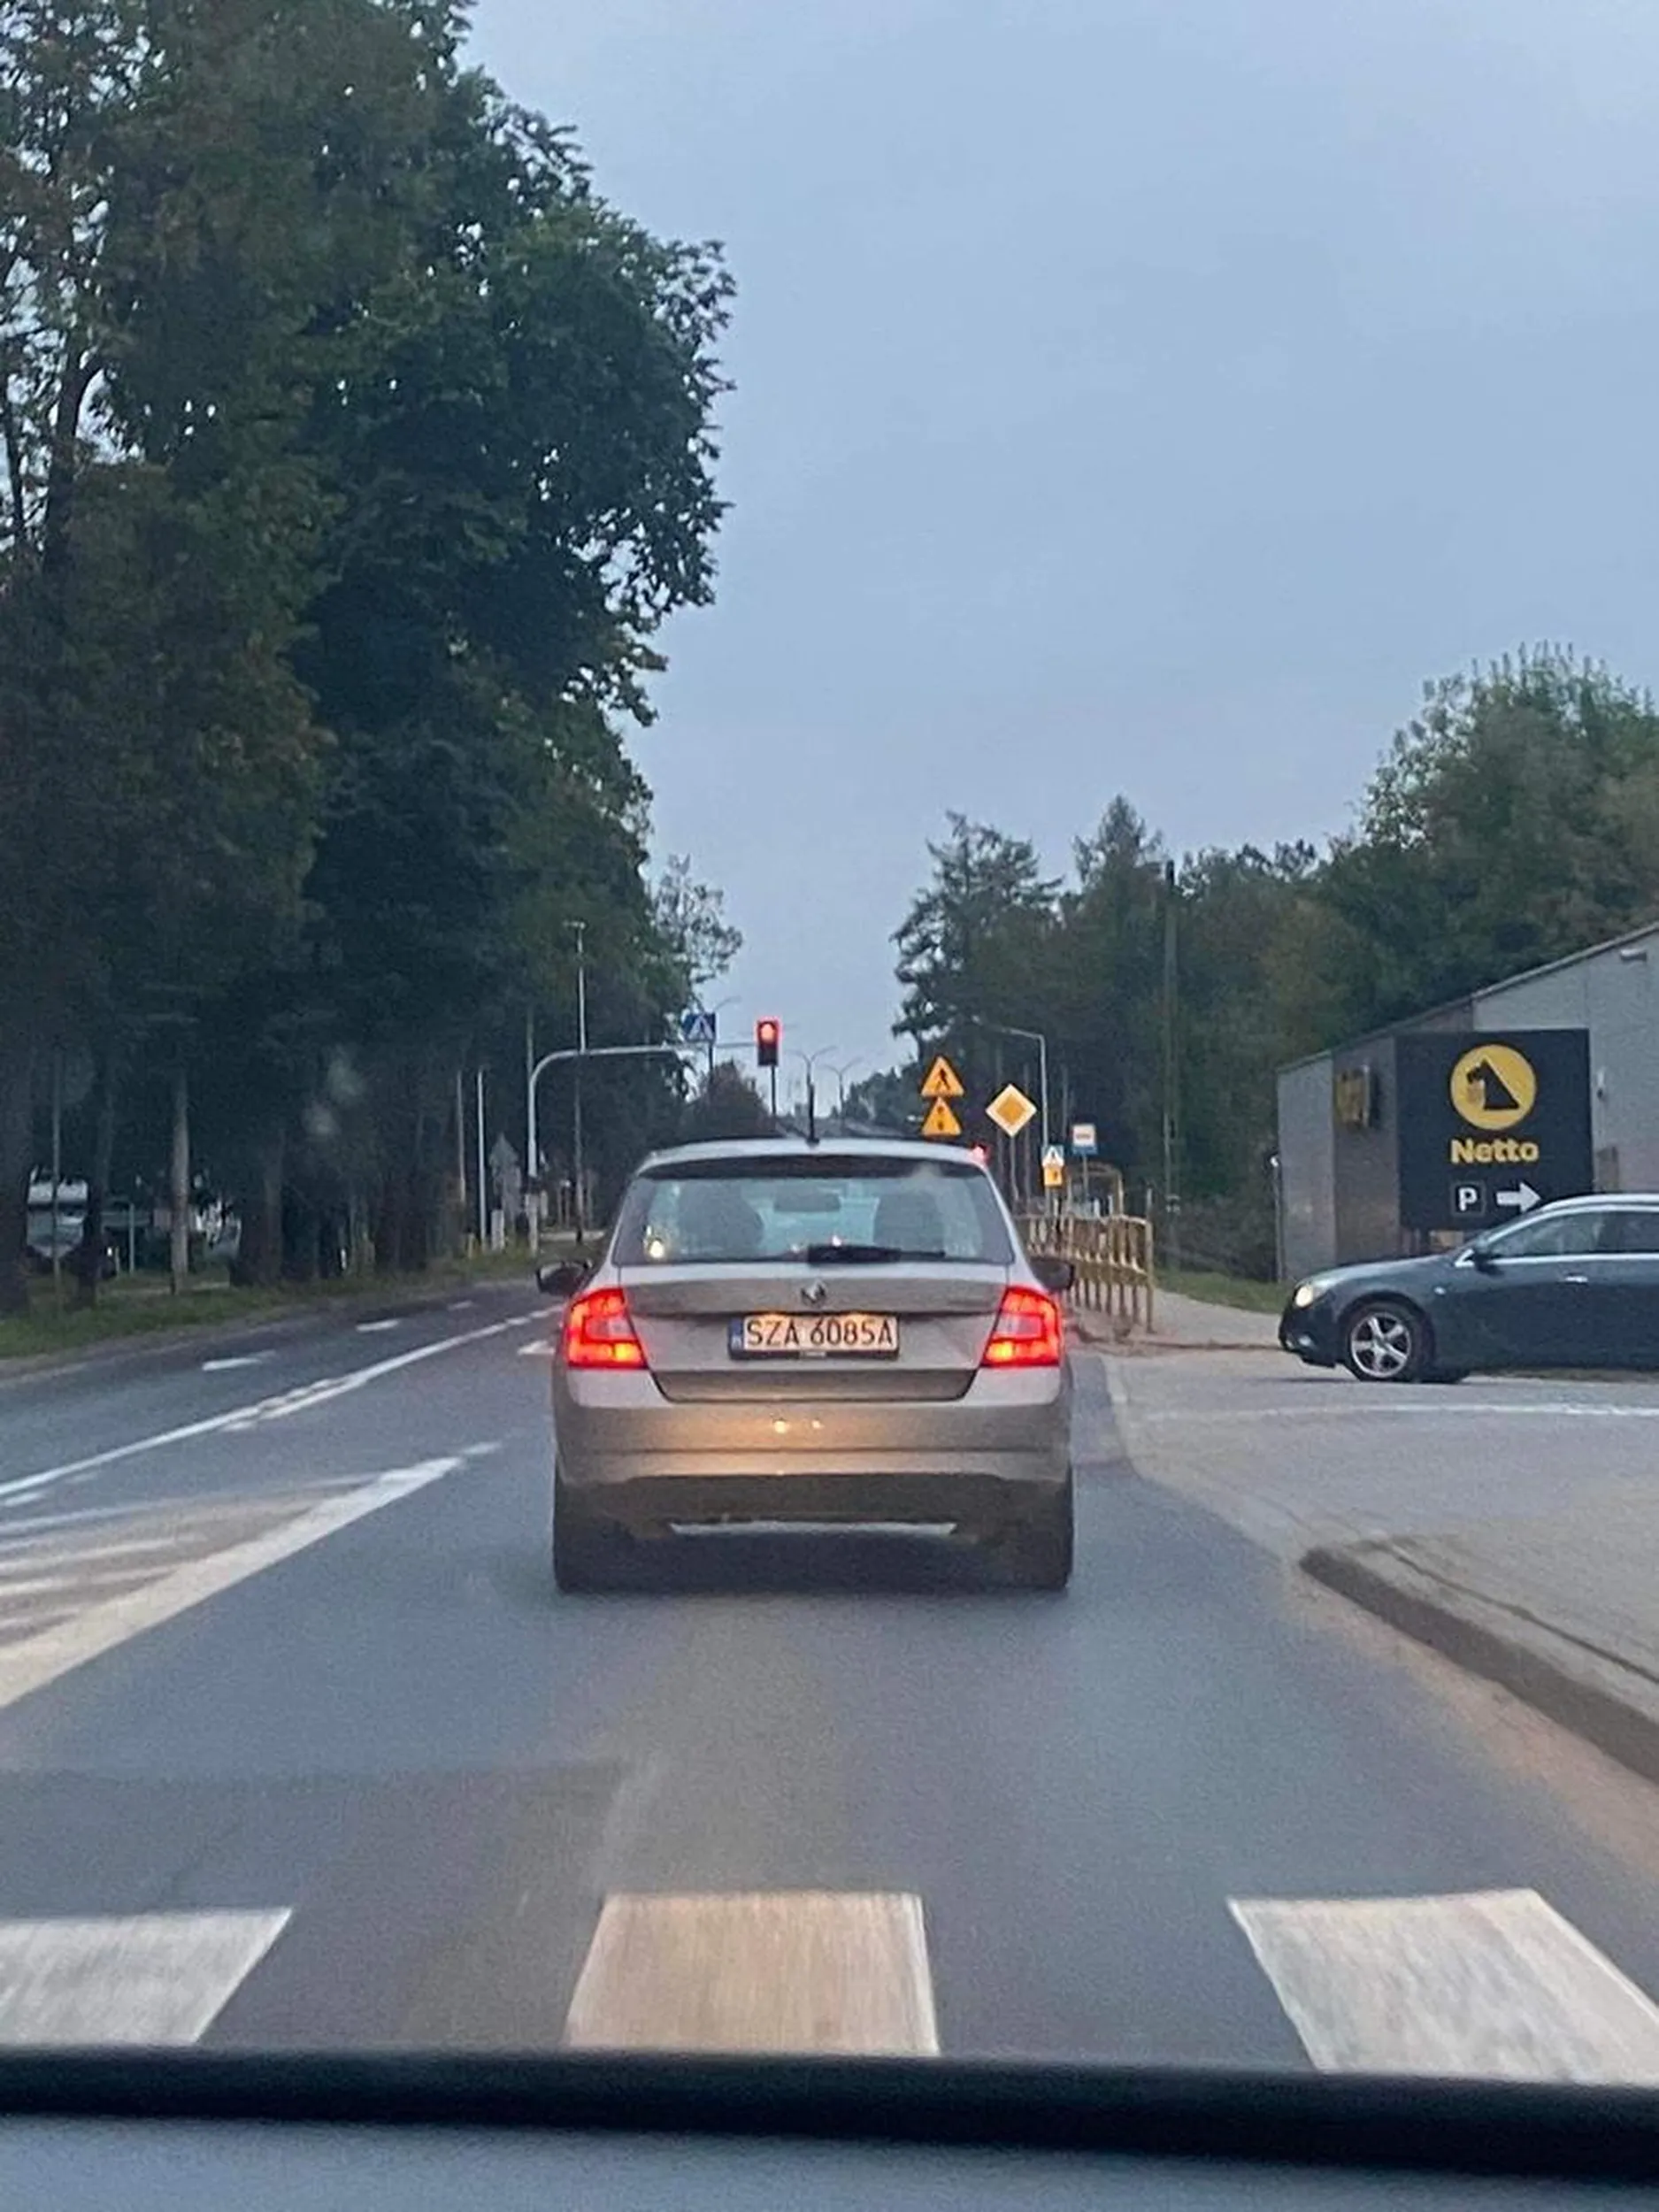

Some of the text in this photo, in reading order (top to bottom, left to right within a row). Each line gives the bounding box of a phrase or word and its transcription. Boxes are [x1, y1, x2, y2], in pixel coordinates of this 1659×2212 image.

[1450, 1138, 1540, 1164] Netto
[1458, 1187, 1478, 1211] P
[746, 1319, 800, 1345] SZA
[810, 1317, 893, 1345] 6085A
